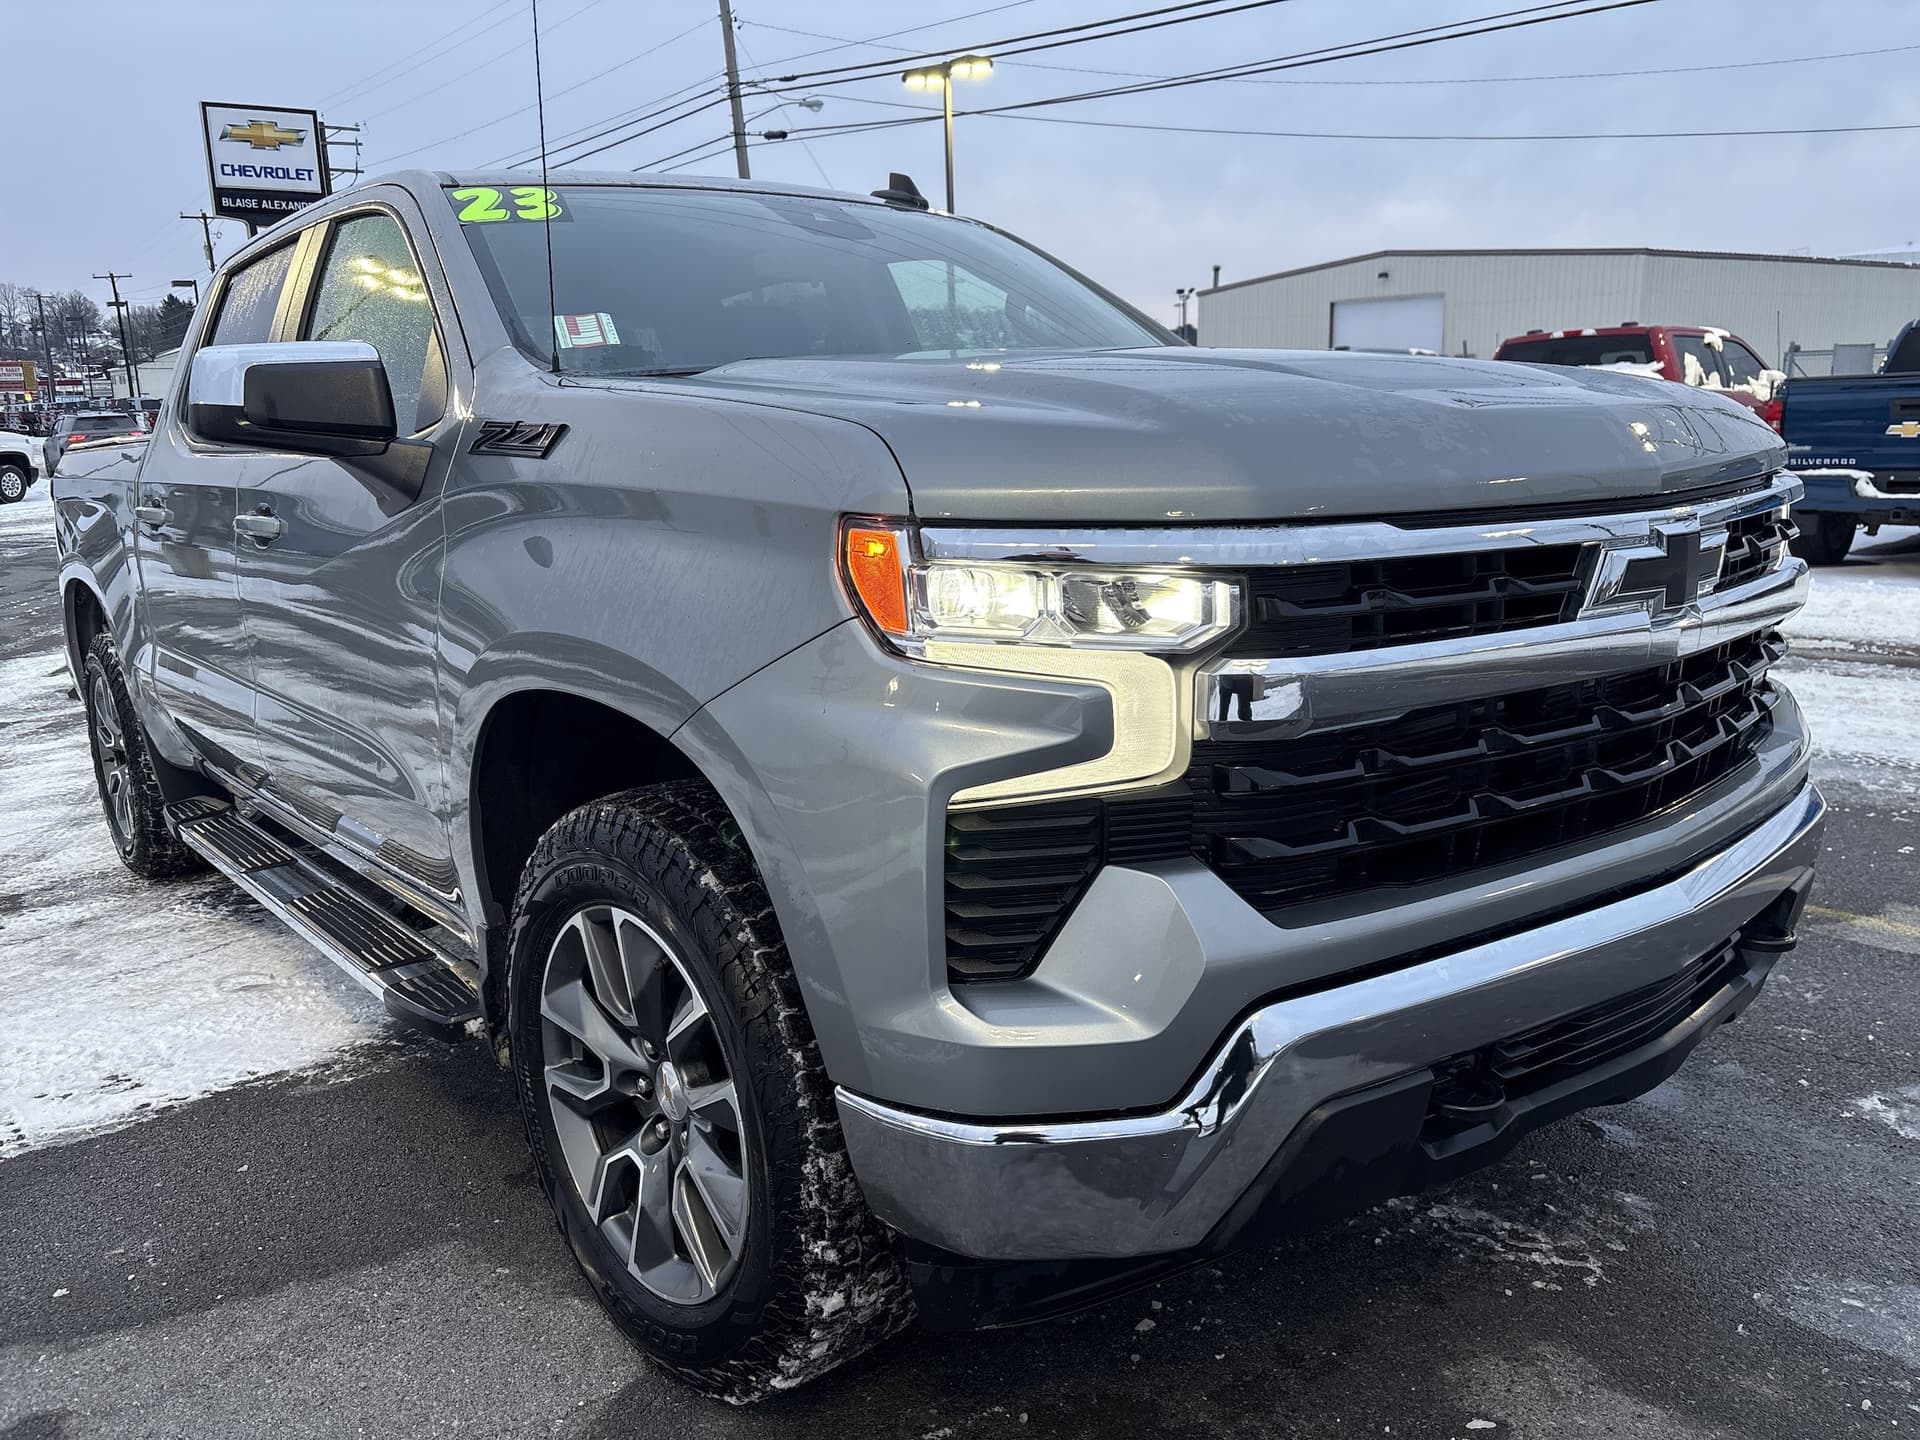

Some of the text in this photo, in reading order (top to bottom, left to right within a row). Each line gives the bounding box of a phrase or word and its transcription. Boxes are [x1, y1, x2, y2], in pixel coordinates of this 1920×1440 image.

[220, 163, 314, 181] CHEVROLET
[222, 197, 311, 211] BLAISE ALEXAND
[452, 187, 562, 223] 23
[1790, 458, 1856, 466] SILVERADO
[554, 865, 650, 912] COOPER
